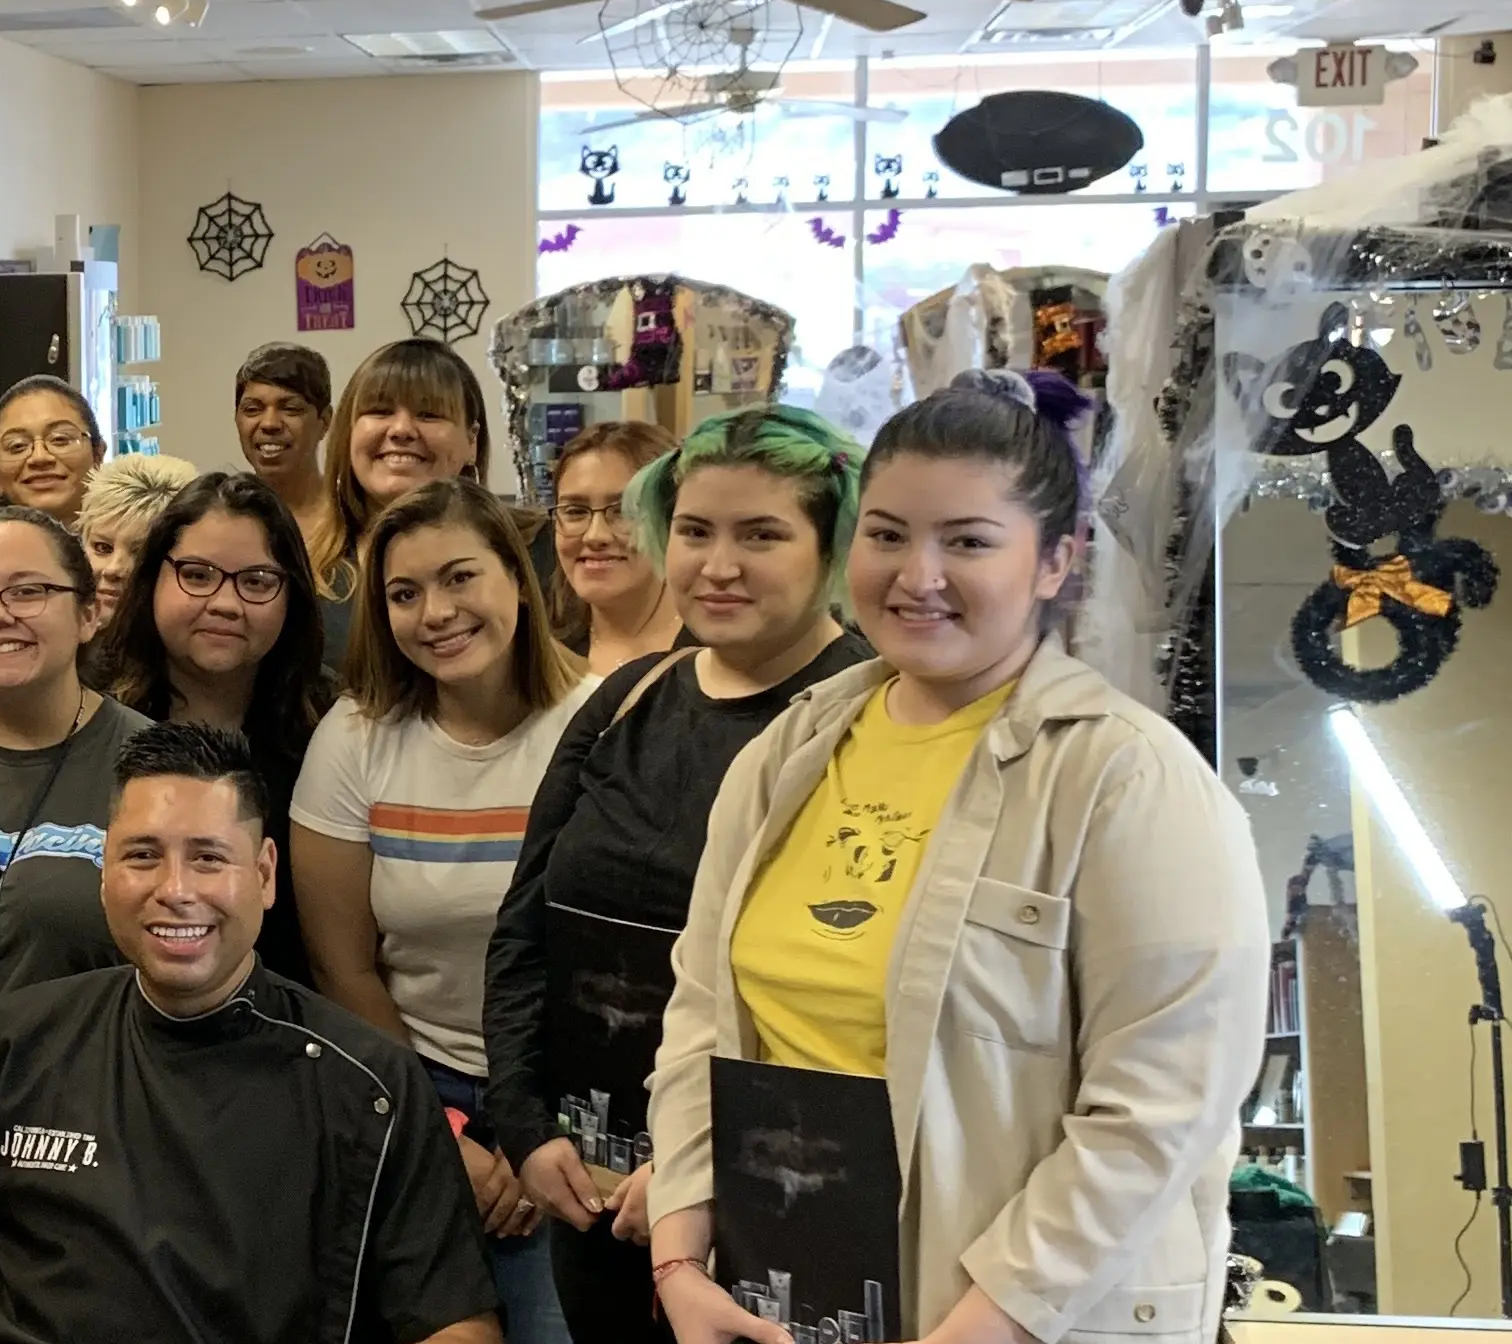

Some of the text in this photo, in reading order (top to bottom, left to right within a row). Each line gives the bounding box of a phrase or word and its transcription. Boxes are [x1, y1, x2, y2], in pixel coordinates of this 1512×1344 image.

[1315, 49, 1372, 88] EXIT
[0, 1130, 99, 1168] JOHNNY B.
